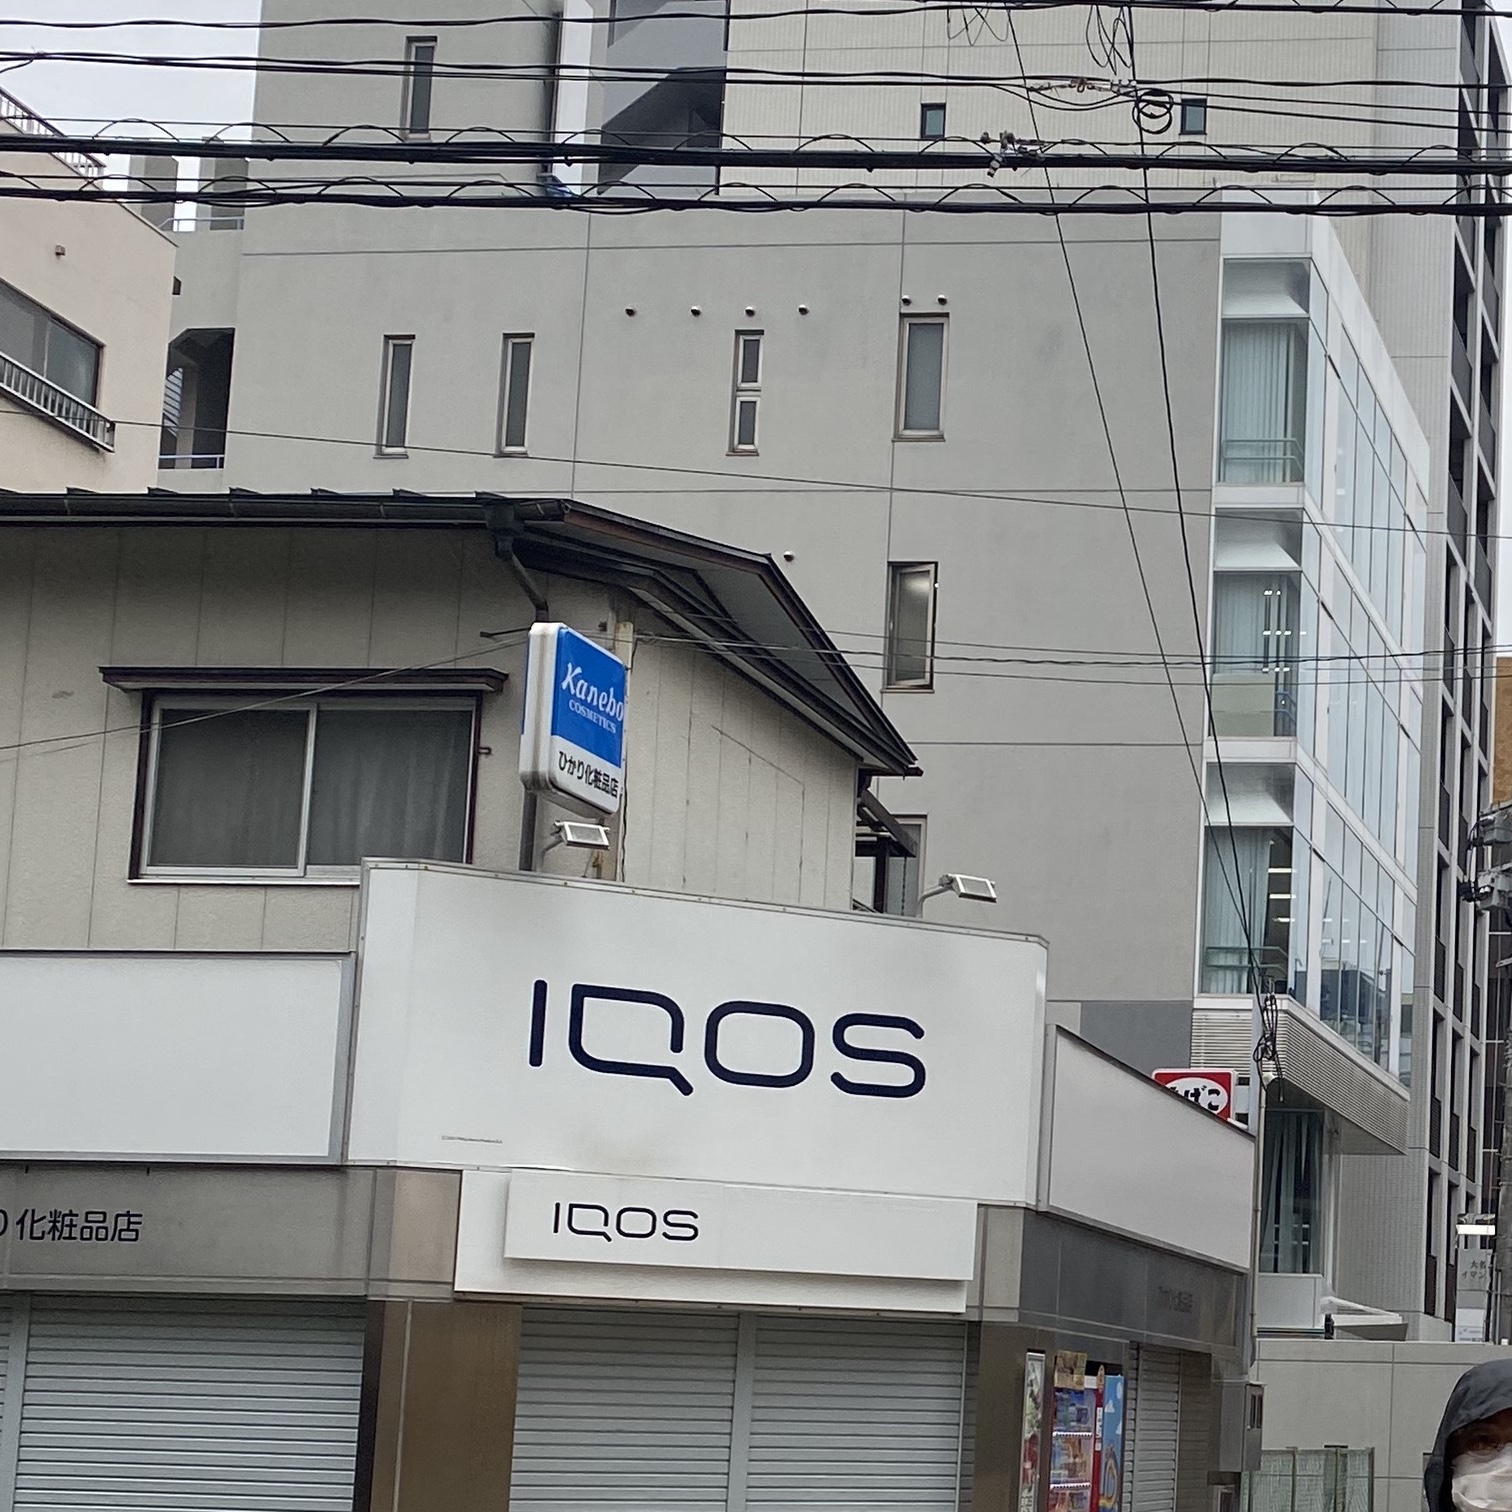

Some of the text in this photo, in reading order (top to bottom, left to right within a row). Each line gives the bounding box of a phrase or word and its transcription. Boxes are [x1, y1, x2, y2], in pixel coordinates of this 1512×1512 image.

[561, 662, 624, 722] Kanebo
[568, 699, 617, 735] COSMETICS
[558, 750, 620, 799] ひかり化粧品店
[529, 979, 926, 1099] IQOS
[553, 1201, 700, 1242] IQOS
